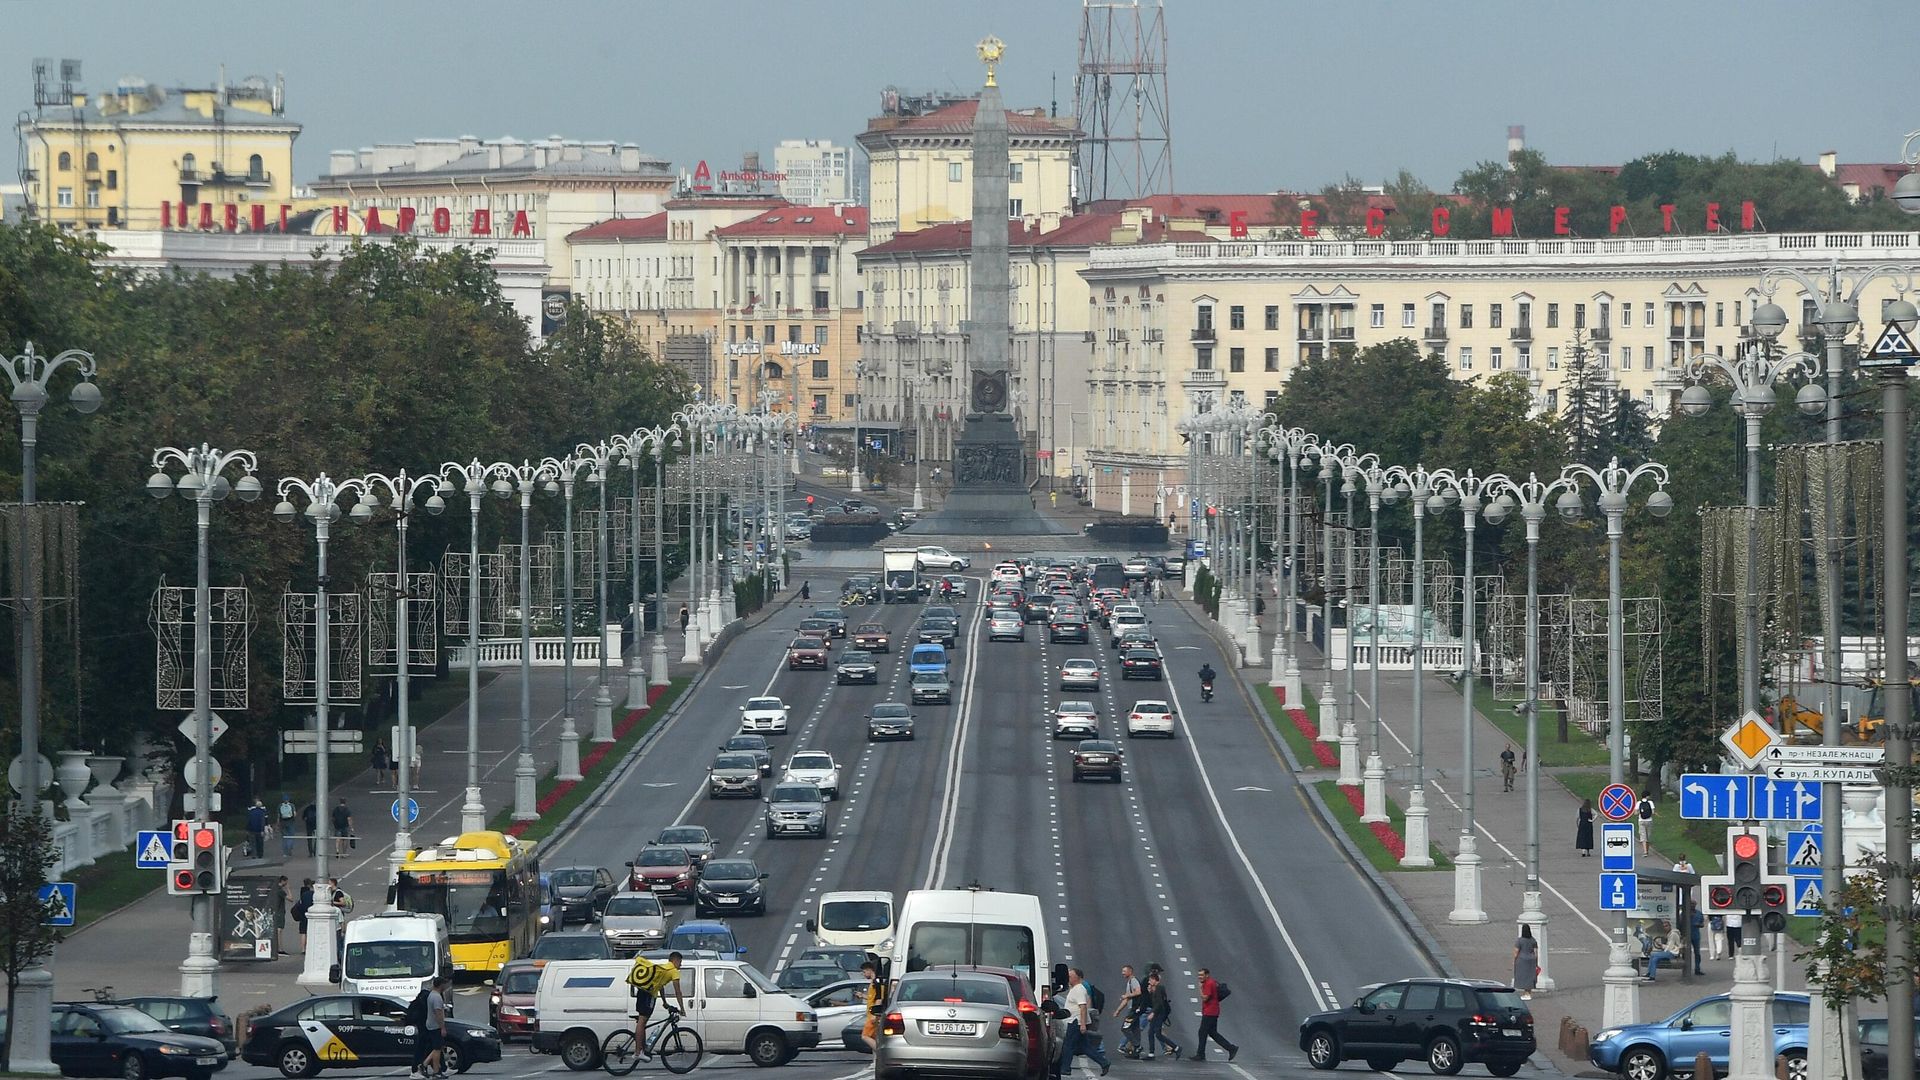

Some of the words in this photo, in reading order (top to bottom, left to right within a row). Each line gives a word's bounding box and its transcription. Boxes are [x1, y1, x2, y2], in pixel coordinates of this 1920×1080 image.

[332, 206, 531, 236] НАРОДА
[1806, 750, 1874, 759] НЕЗАЛЕЖНАСЦІ
[1790, 771, 1810, 779] вул.
[338, 1025, 354, 1033] 9097
[327, 1042, 349, 1061] Go
